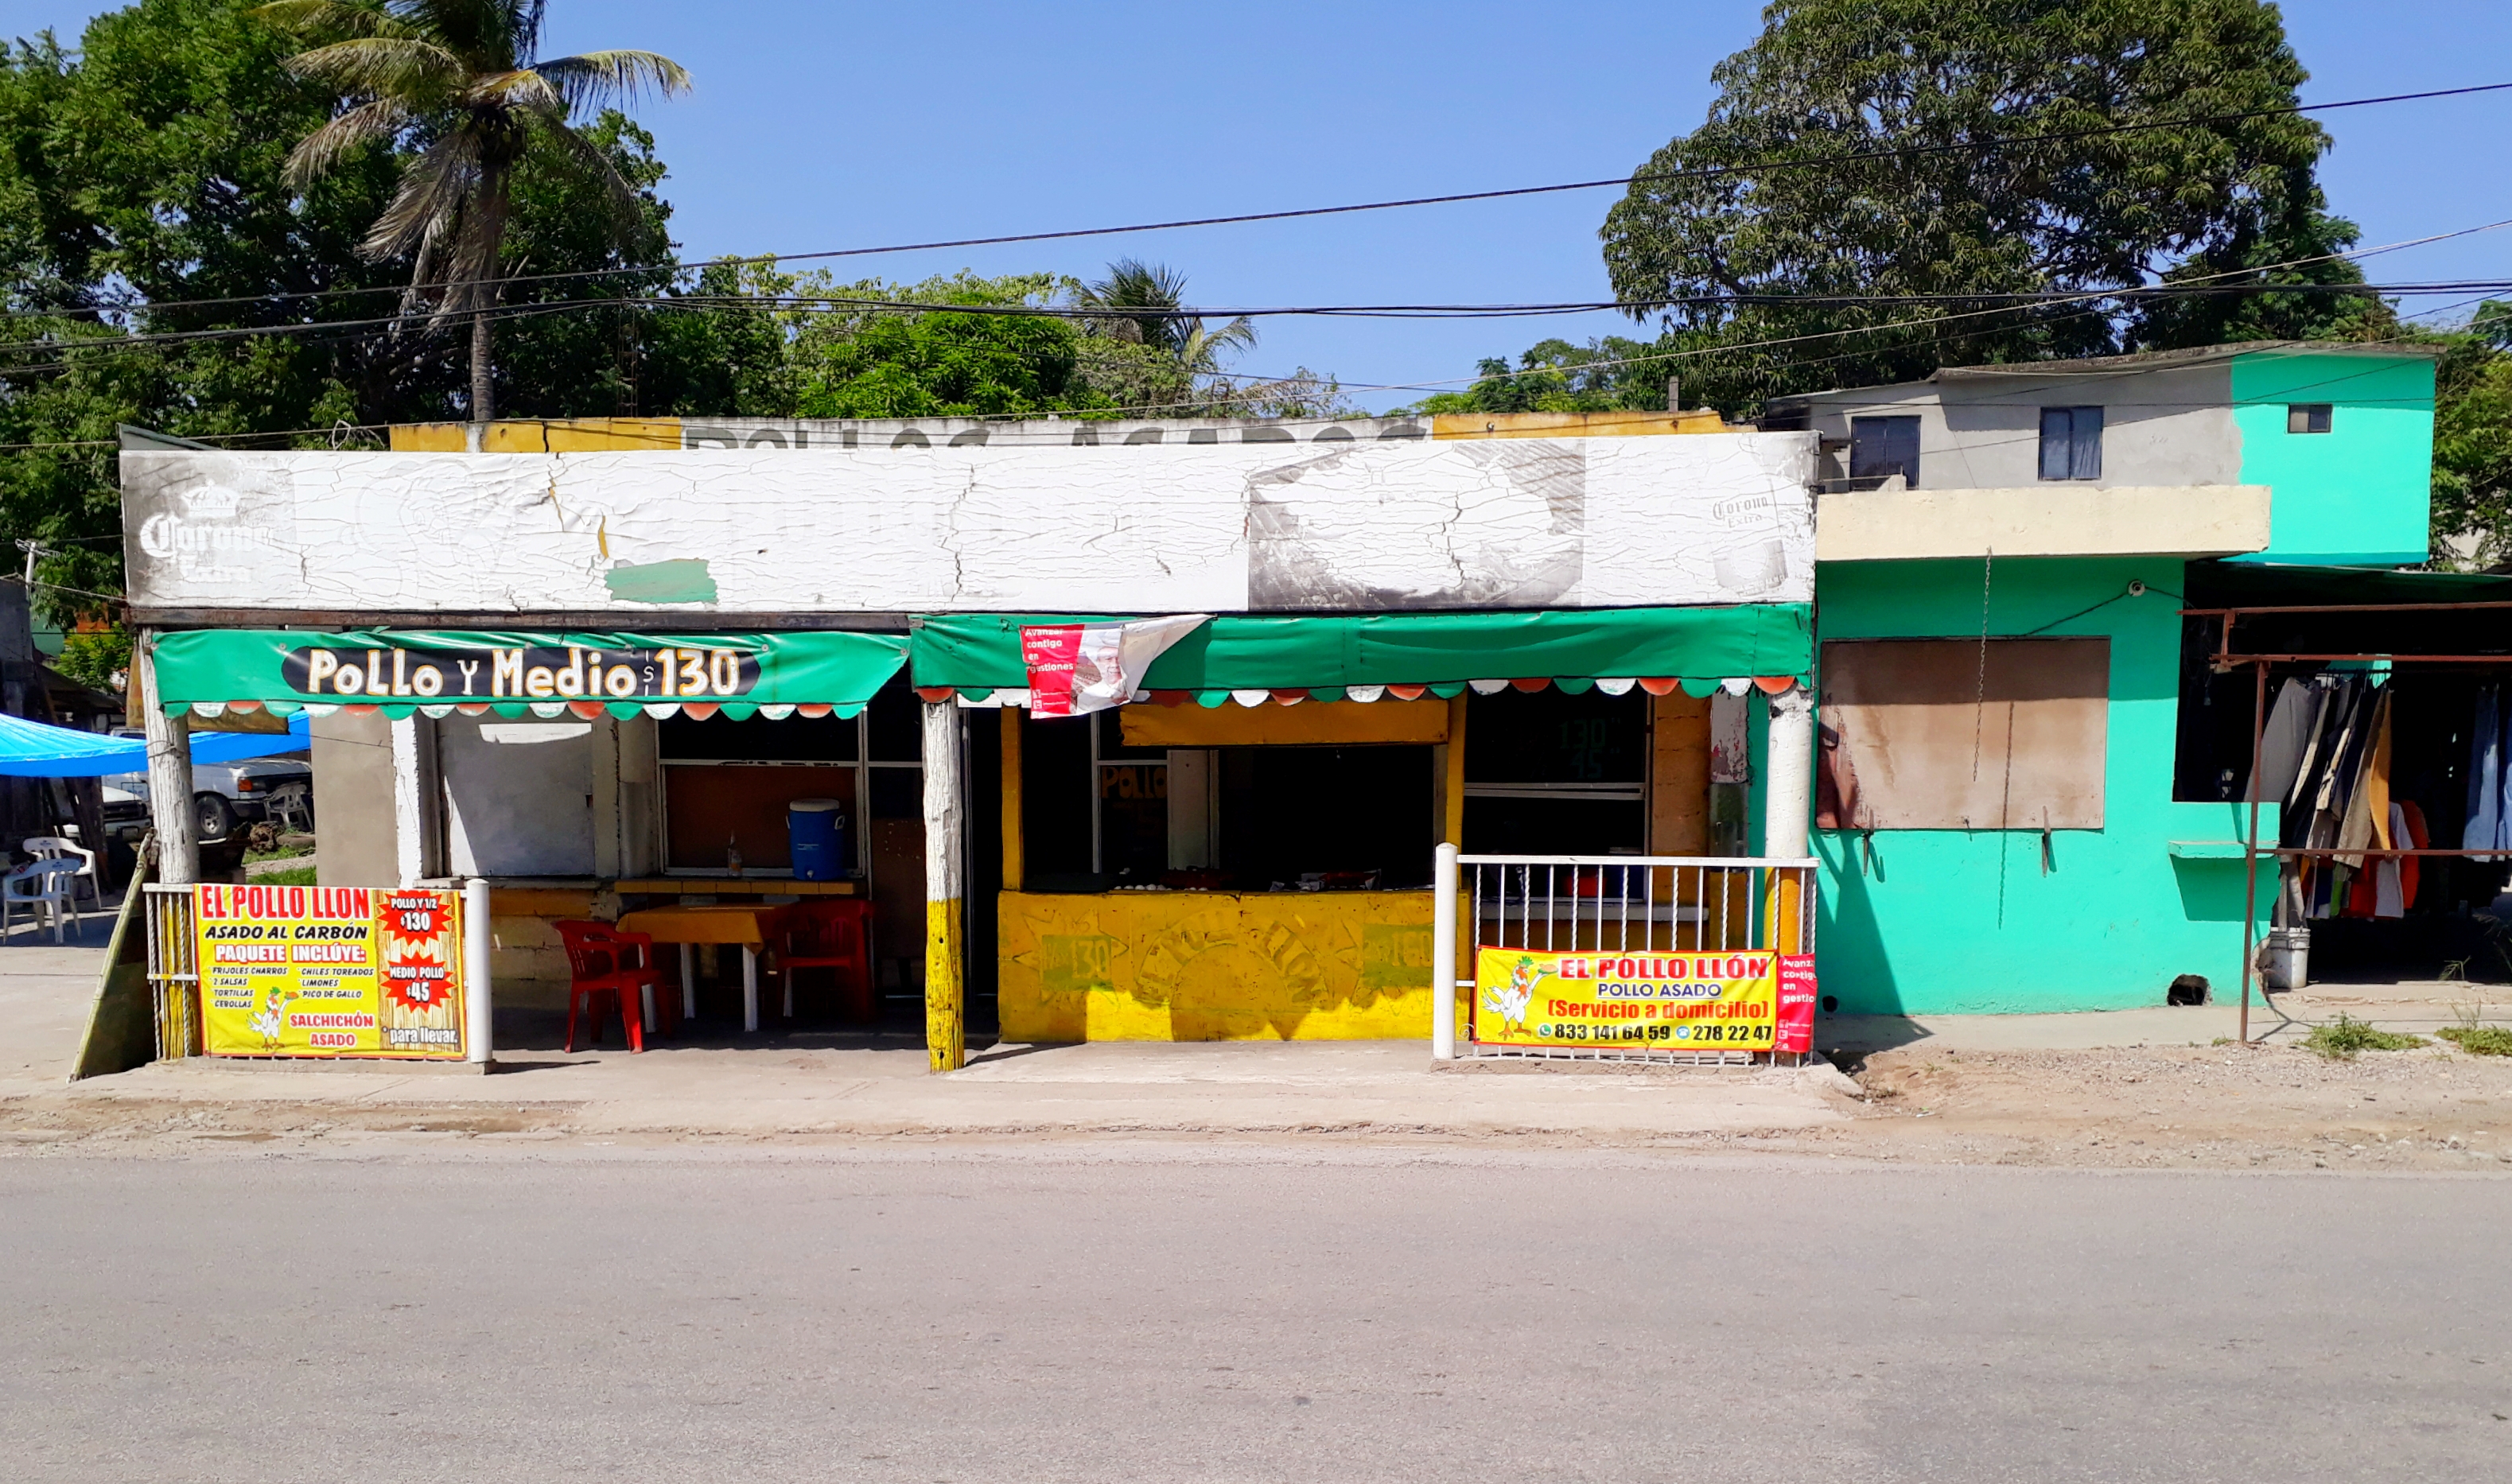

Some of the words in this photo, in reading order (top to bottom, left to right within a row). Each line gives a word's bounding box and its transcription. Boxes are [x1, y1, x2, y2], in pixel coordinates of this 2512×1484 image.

[1713, 496, 1768, 521] Corona
[1728, 513, 1762, 529] Extra
[1027, 639, 1063, 649] contigo
[492, 647, 638, 698] Medio
[1030, 663, 1074, 674] gestiones
[201, 886, 227, 919] EL
[232, 886, 305, 919] POLLO
[391, 898, 416, 909] POLLO
[418, 898, 424, 909] Y
[425, 898, 437, 909] 1/2
[400, 911, 430, 931] $130
[205, 926, 263, 939] ASADO
[267, 926, 288, 939] AL
[294, 922, 368, 939] CARBÓN
[215, 944, 286, 964] PAQUETE
[291, 942, 367, 963] INCLÚYE:
[390, 966, 416, 978] MEDIO
[419, 966, 445, 979] POLLO
[1559, 958, 1590, 979] EL
[1597, 958, 1683, 979] POLLO
[1696, 954, 1768, 979] LLÓN
[406, 982, 430, 1002] $45
[1598, 983, 1654, 997] POLLO
[1659, 983, 1722, 997] ASADO
[1645, 1003, 1657, 1019] a
[290, 1012, 374, 1027] SALCHICHÓN
[310, 1034, 356, 1046] ASADO
[390, 1029, 419, 1044] para
[421, 1028, 459, 1043] llevar.
[1555, 1024, 1588, 1040] 833
[1592, 1025, 1618, 1040] 141
[1623, 1025, 1644, 1040] 64
[1648, 1025, 1670, 1040] 59
[1693, 1025, 1724, 1041] 278
[1728, 1025, 1749, 1041] 22
[1753, 1026, 1772, 1041] 47
